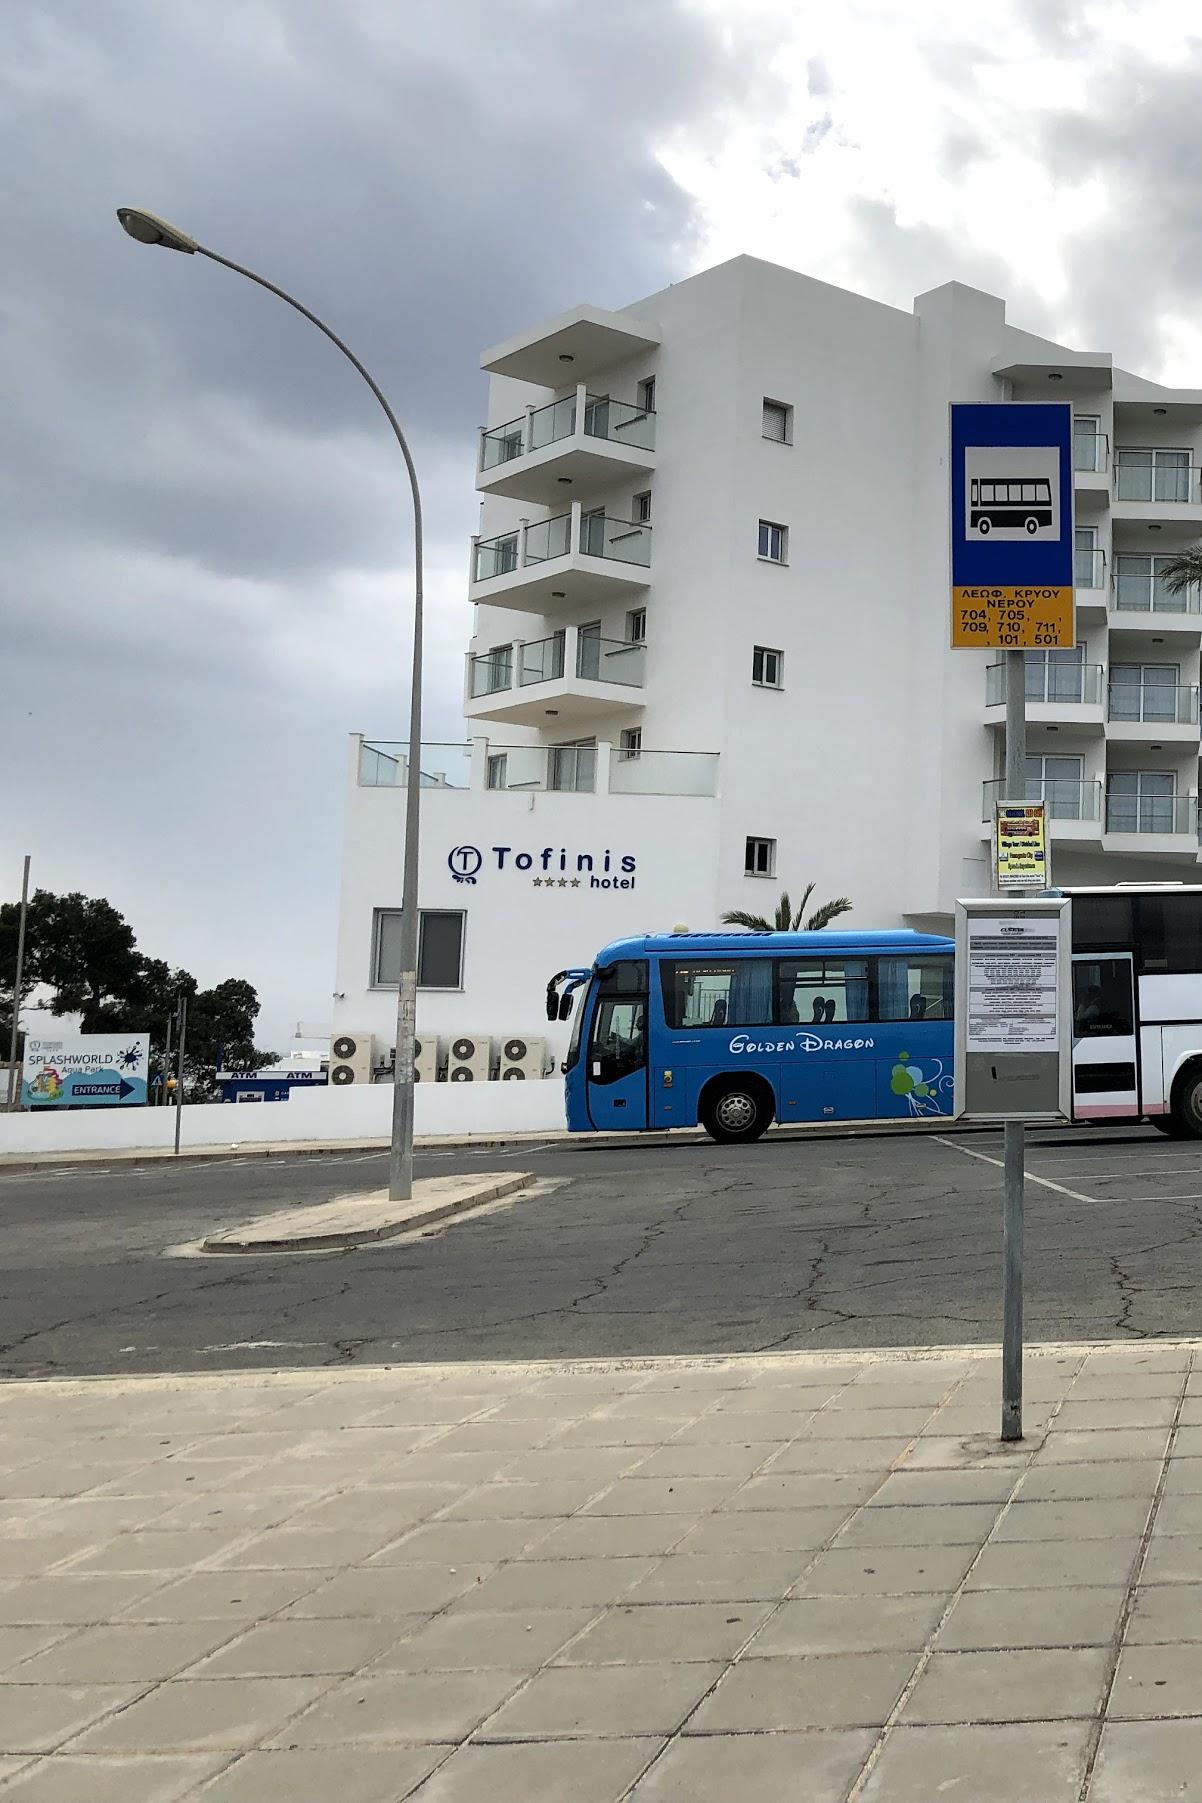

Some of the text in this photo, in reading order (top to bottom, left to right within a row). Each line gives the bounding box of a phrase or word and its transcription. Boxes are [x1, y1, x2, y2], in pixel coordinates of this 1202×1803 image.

[1014, 589, 1060, 599] ΚΡΥΟΥ
[986, 599, 1035, 609] ΝΕΡΟΥ
[961, 622, 989, 633] 709,
[1034, 634, 1059, 645] 501
[492, 847, 636, 873] Tofinis
[590, 875, 635, 889] hotel
[28, 1053, 114, 1066] SPLASHWORLD
[84, 1065, 104, 1073] Park
[74, 1085, 120, 1094] ENTRANCE
